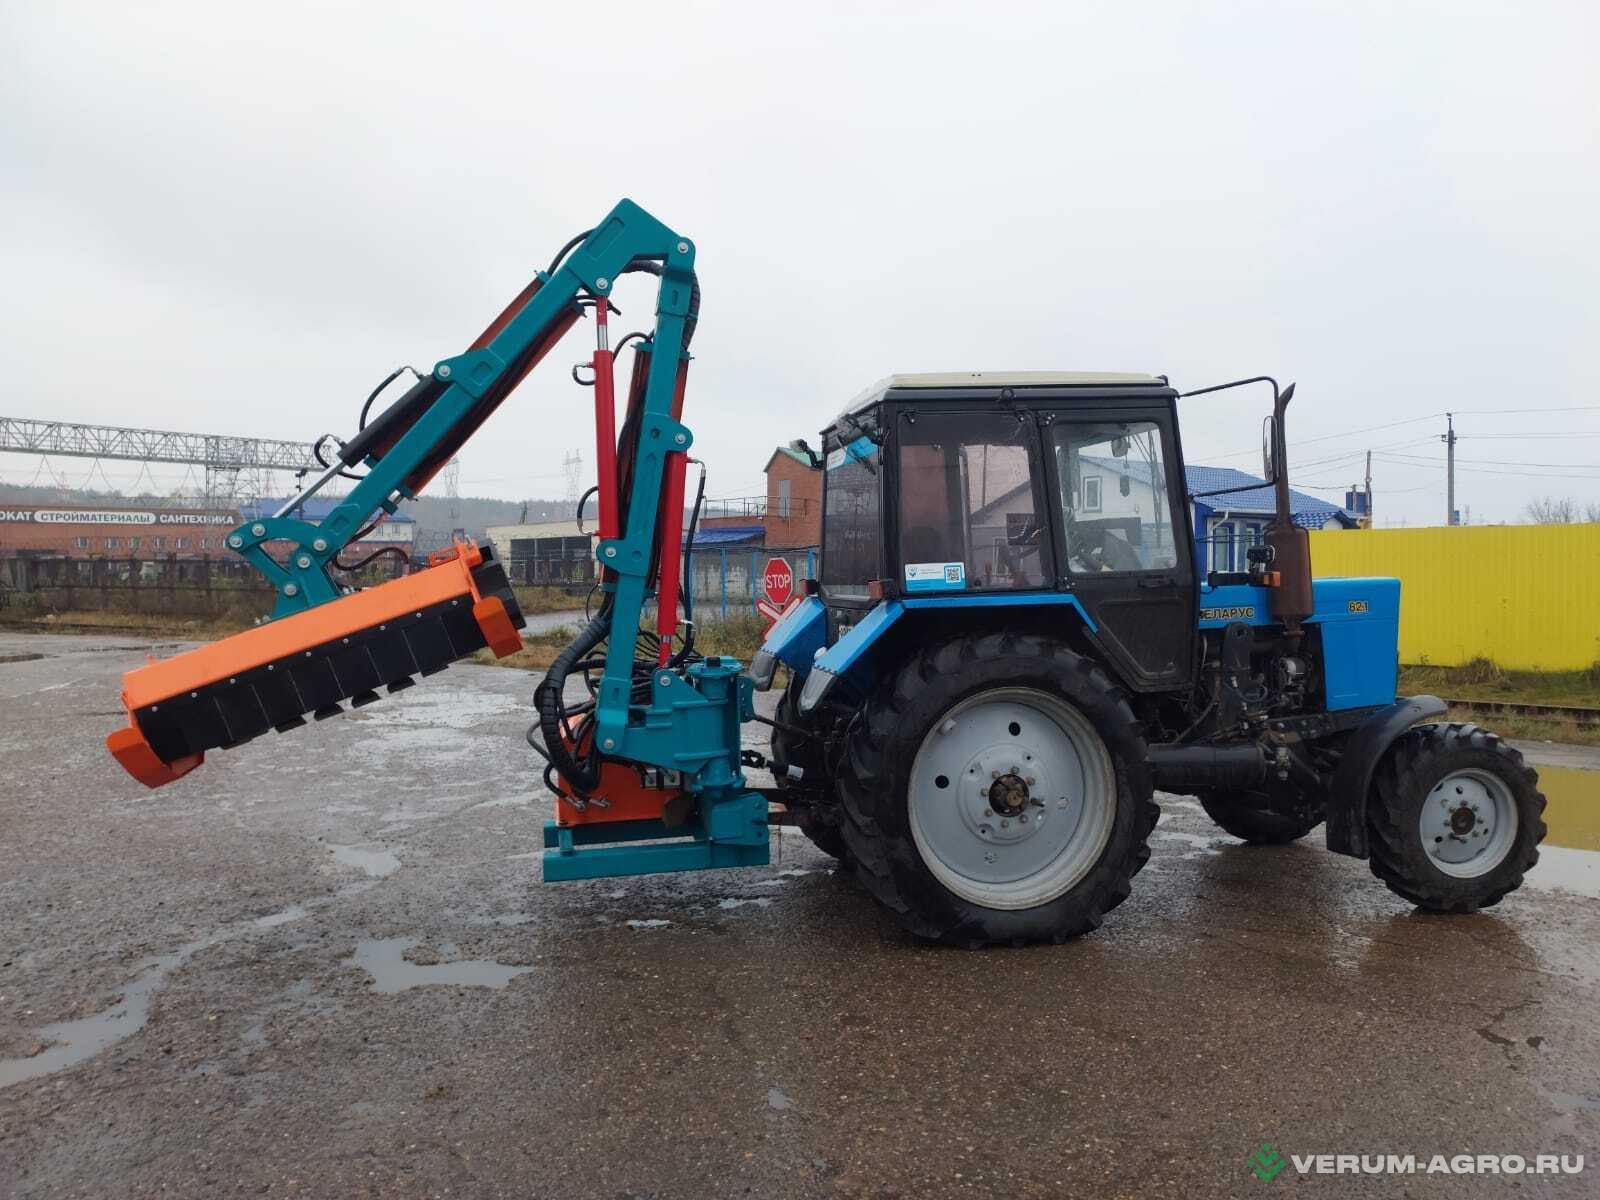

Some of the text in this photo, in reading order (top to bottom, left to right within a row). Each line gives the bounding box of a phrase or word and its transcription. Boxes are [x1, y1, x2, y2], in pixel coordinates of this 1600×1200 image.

[40, 512, 150, 523] СТРОЙМАТЕРИАЛЫ
[159, 514, 235, 525] САНТЕХНИКА
[766, 574, 791, 589] STOP
